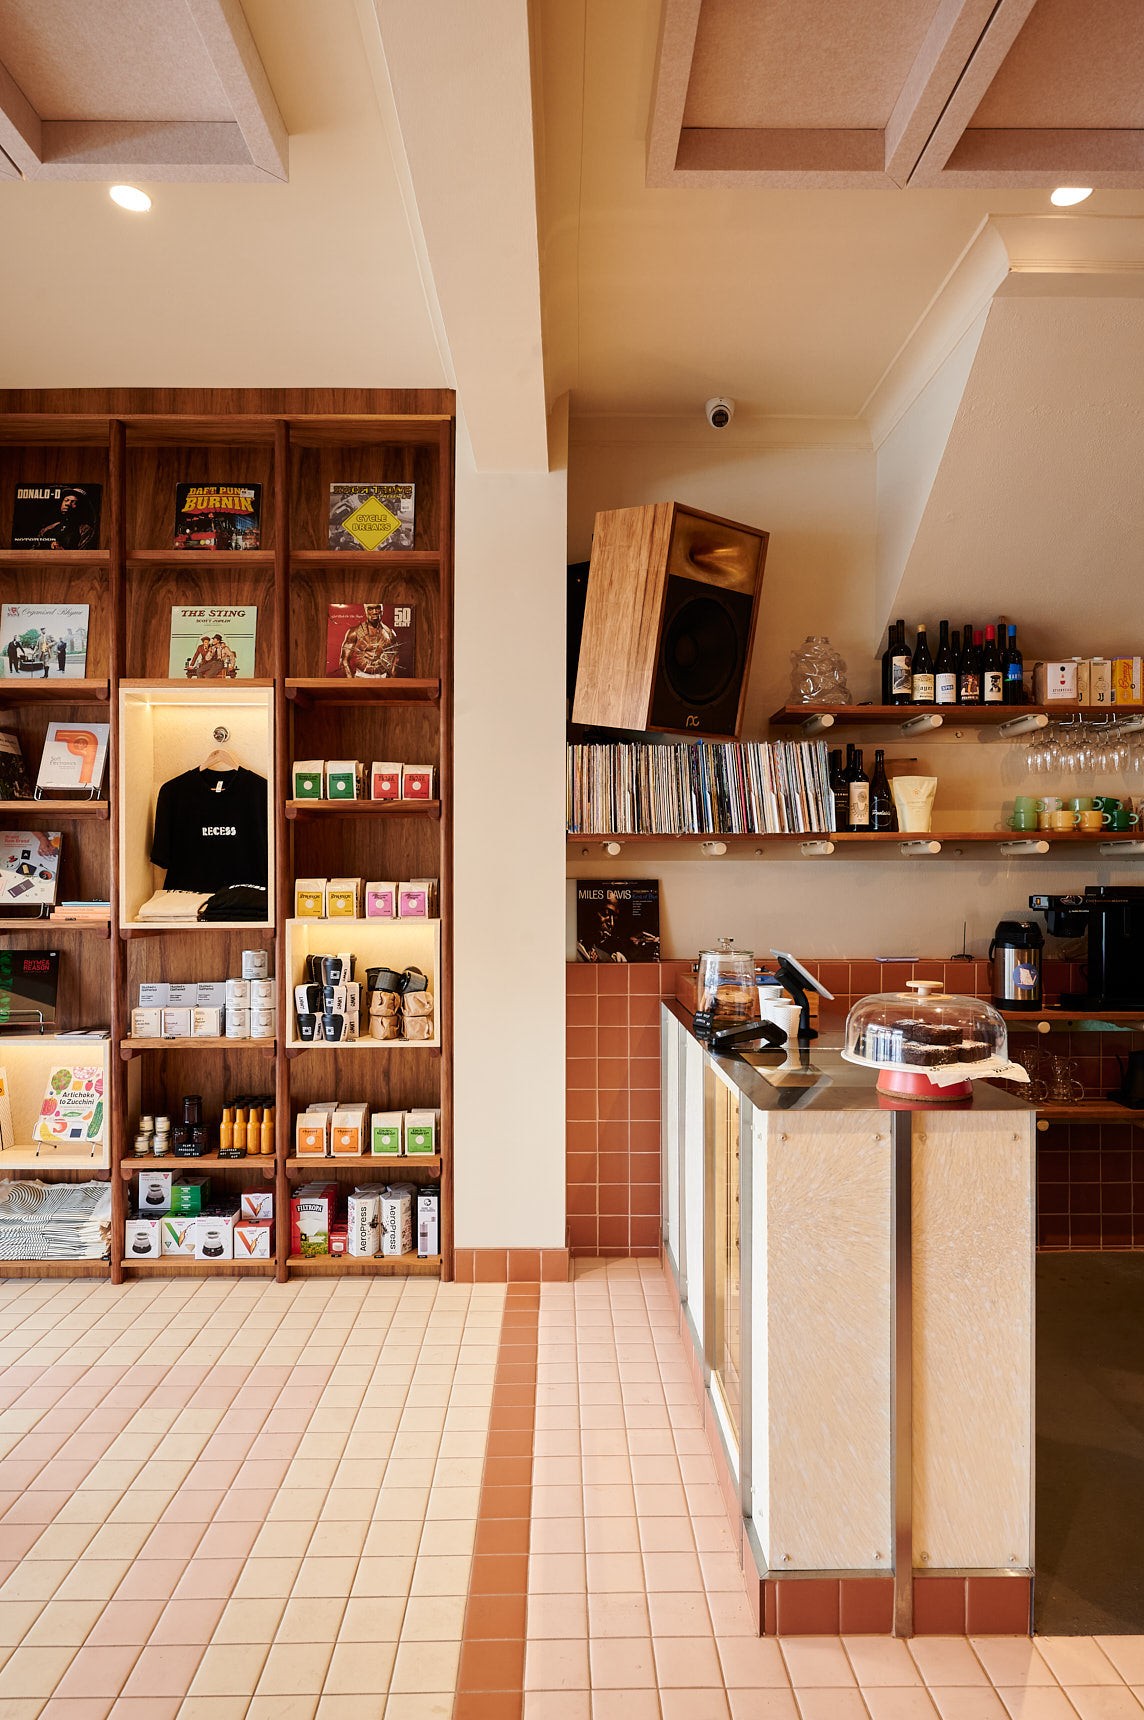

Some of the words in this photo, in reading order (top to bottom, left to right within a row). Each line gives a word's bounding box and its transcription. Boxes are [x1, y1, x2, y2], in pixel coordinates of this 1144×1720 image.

[352, 523, 391, 532] BREAKS
[394, 608, 411, 622] 50
[202, 827, 236, 836] RECESS
[578, 890, 604, 900] MILES
[607, 890, 632, 900] DAVIS
[297, 1204, 322, 1212] FILTROPA
